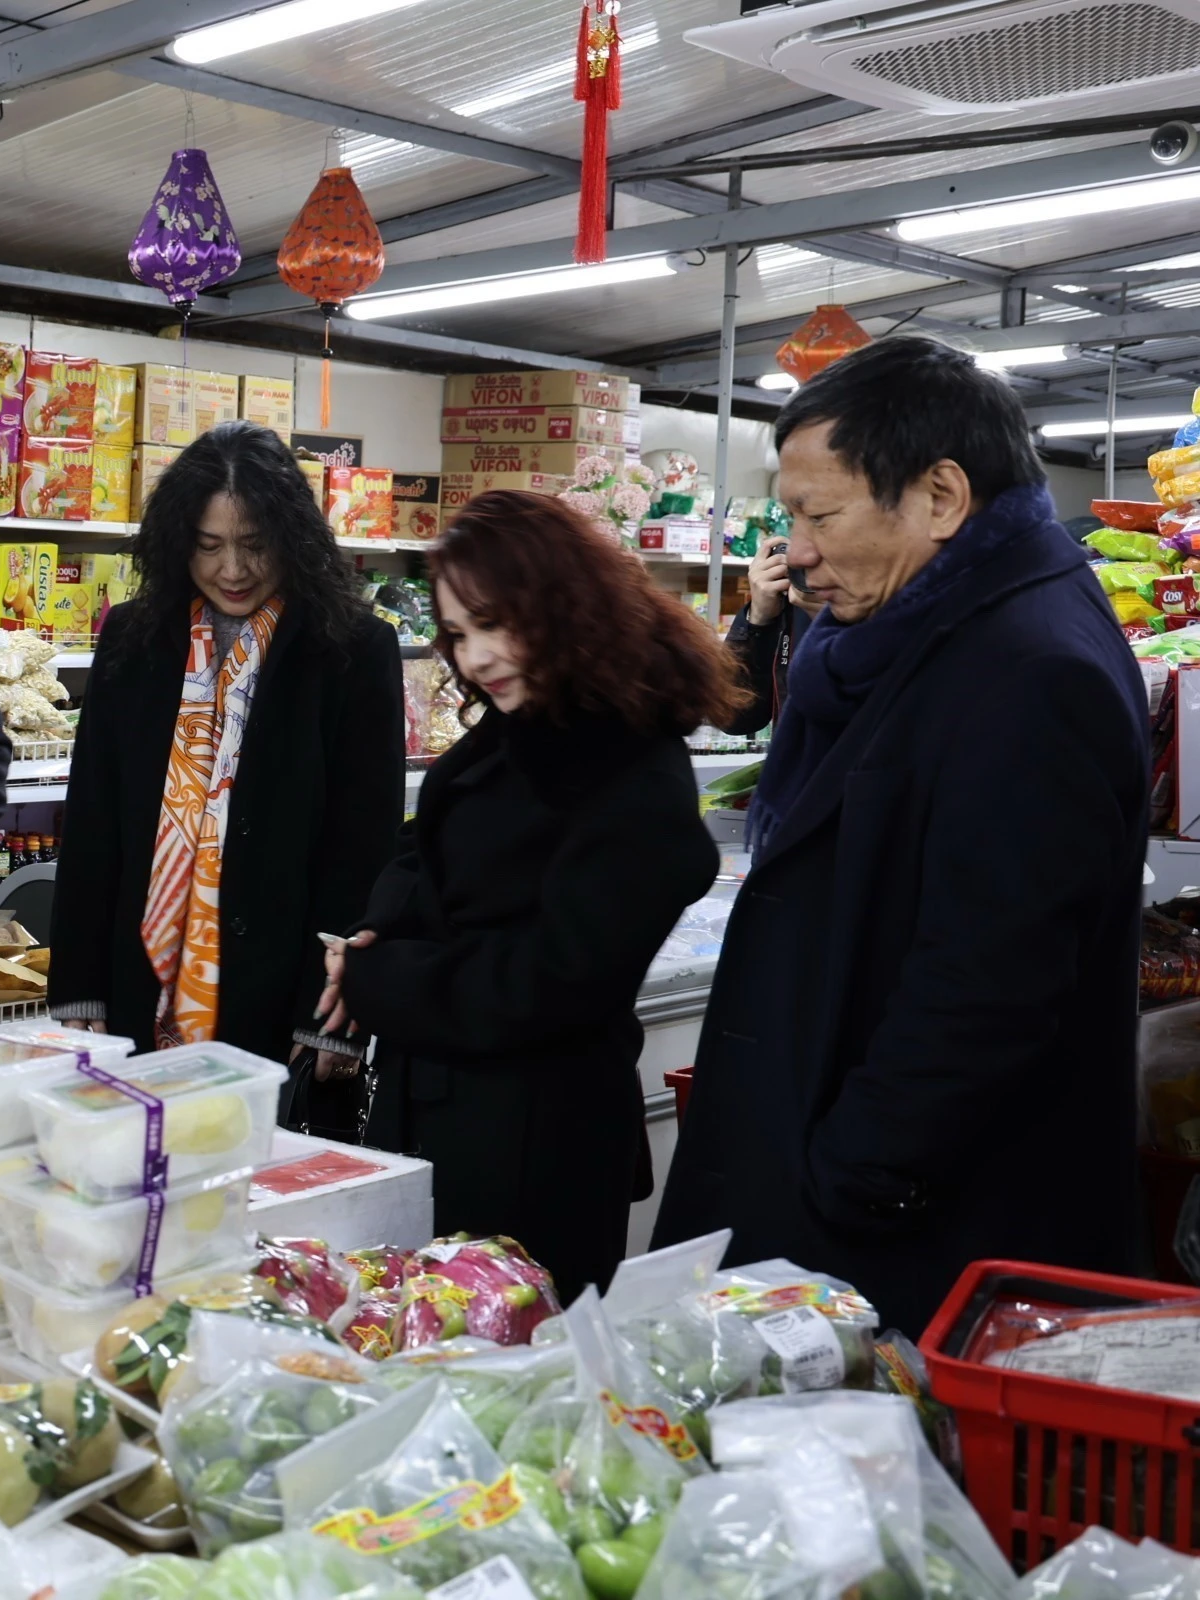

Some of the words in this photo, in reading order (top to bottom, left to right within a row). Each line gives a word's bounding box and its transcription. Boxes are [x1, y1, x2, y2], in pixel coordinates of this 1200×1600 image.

[471, 389, 522, 404] VIFON
[582, 390, 620, 407] VIFON
[38, 553, 50, 611] Custas
[1162, 590, 1183, 602] COSY
